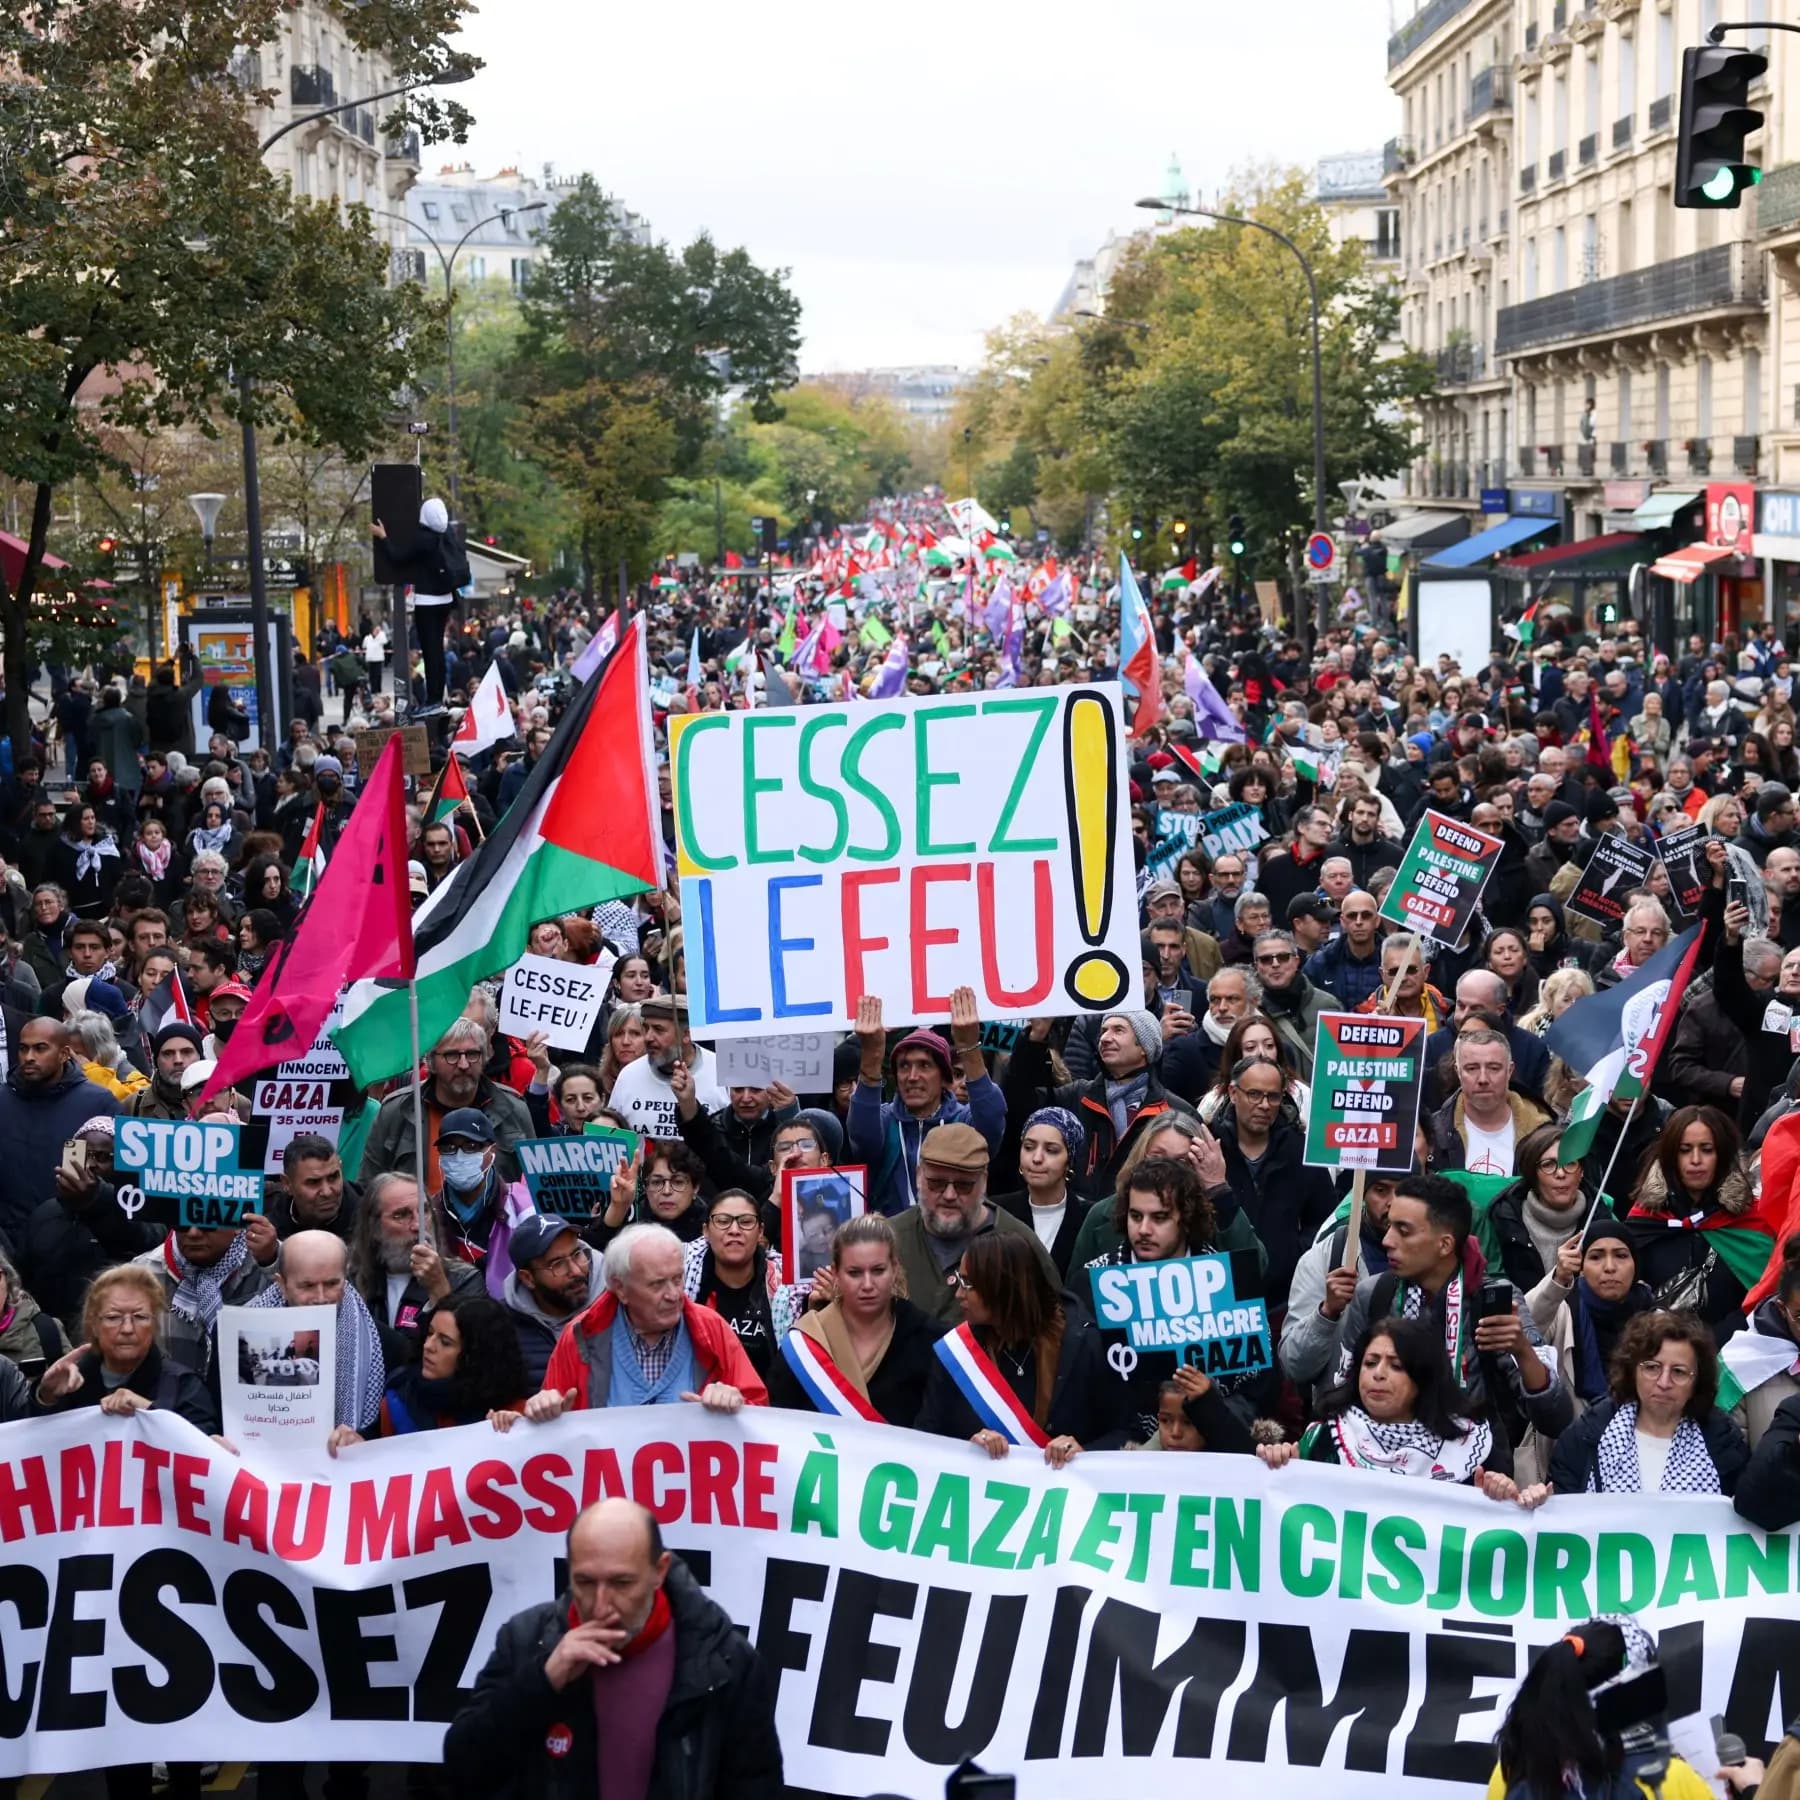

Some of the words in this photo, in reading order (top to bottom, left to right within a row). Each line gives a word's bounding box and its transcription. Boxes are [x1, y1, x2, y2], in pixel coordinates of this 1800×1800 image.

[676, 696, 1059, 870] CESSEZ
[1202, 812, 1271, 861] PAIX
[1436, 824, 1481, 853] DEFEND
[1418, 846, 1479, 879] PALESTINE
[1414, 870, 1459, 898] DEFEND
[1406, 897, 1440, 918] GAZA
[698, 874, 833, 1024] LE
[514, 968, 595, 1002] CESSEZ-
[510, 996, 577, 1028] LE-FEU
[1340, 1025, 1400, 1044] DEFEND
[280, 1062, 348, 1075] INNOCENT
[1327, 1060, 1408, 1077] PALESTINE
[260, 1082, 325, 1110] GAZA
[1333, 1093, 1393, 1111] DEFEND
[276, 1115, 294, 1125] 35
[296, 1114, 339, 1125] JOURS
[119, 1121, 234, 1173] STOP
[1334, 1127, 1379, 1143] GAZA
[519, 1141, 627, 1175] MARCHE
[144, 1168, 260, 1199] MASSACRE
[539, 1173, 588, 1188] CONTRE
[588, 1173, 600, 1187] LA
[186, 1197, 257, 1226] GAZA
[1098, 1259, 1226, 1322] STOP
[730, 1317, 766, 1336] AZA
[1131, 1305, 1264, 1346] MASSACRE
[1184, 1334, 1267, 1374] GAZA
[0, 1441, 212, 1543] HALTE
[223, 1468, 332, 1562] AU
[344, 1440, 779, 1565] MASSACRE
[791, 1432, 839, 1539] À
[858, 1462, 1069, 1570] GAZA
[1069, 1492, 1165, 1584] ET
[1170, 1494, 1261, 1593] EN
[1279, 1503, 1800, 1619] CISJORDAN
[0, 1548, 493, 1739] CESSEZ
[546, 1736, 568, 1753] cgt
